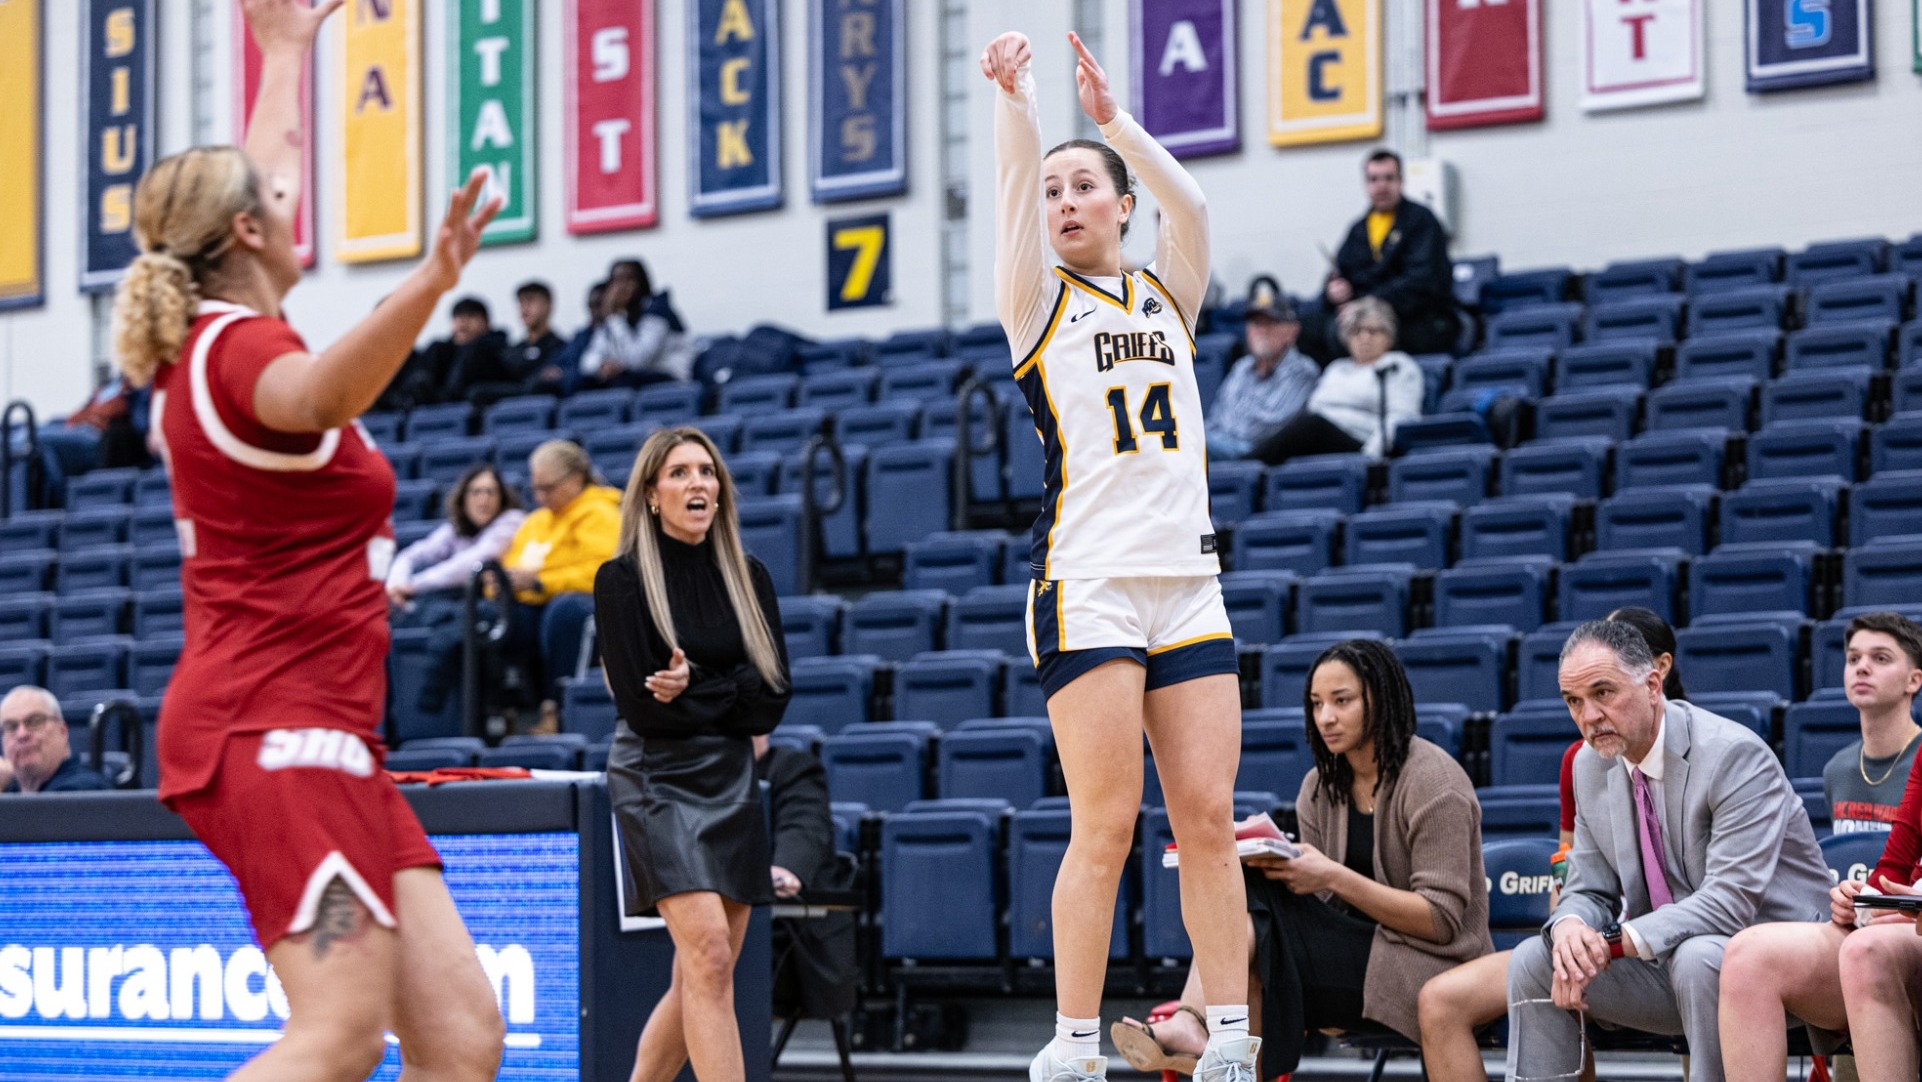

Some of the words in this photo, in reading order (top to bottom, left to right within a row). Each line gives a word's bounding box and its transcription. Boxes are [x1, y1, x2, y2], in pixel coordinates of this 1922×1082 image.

[839, 0, 877, 163] RYS
[1158, 19, 1209, 77] A
[101, 6, 137, 234] SIUS
[591, 25, 632, 174] ST
[832, 224, 885, 301] 7
[1093, 330, 1175, 373] GRIFFS
[1105, 381, 1180, 456] 14
